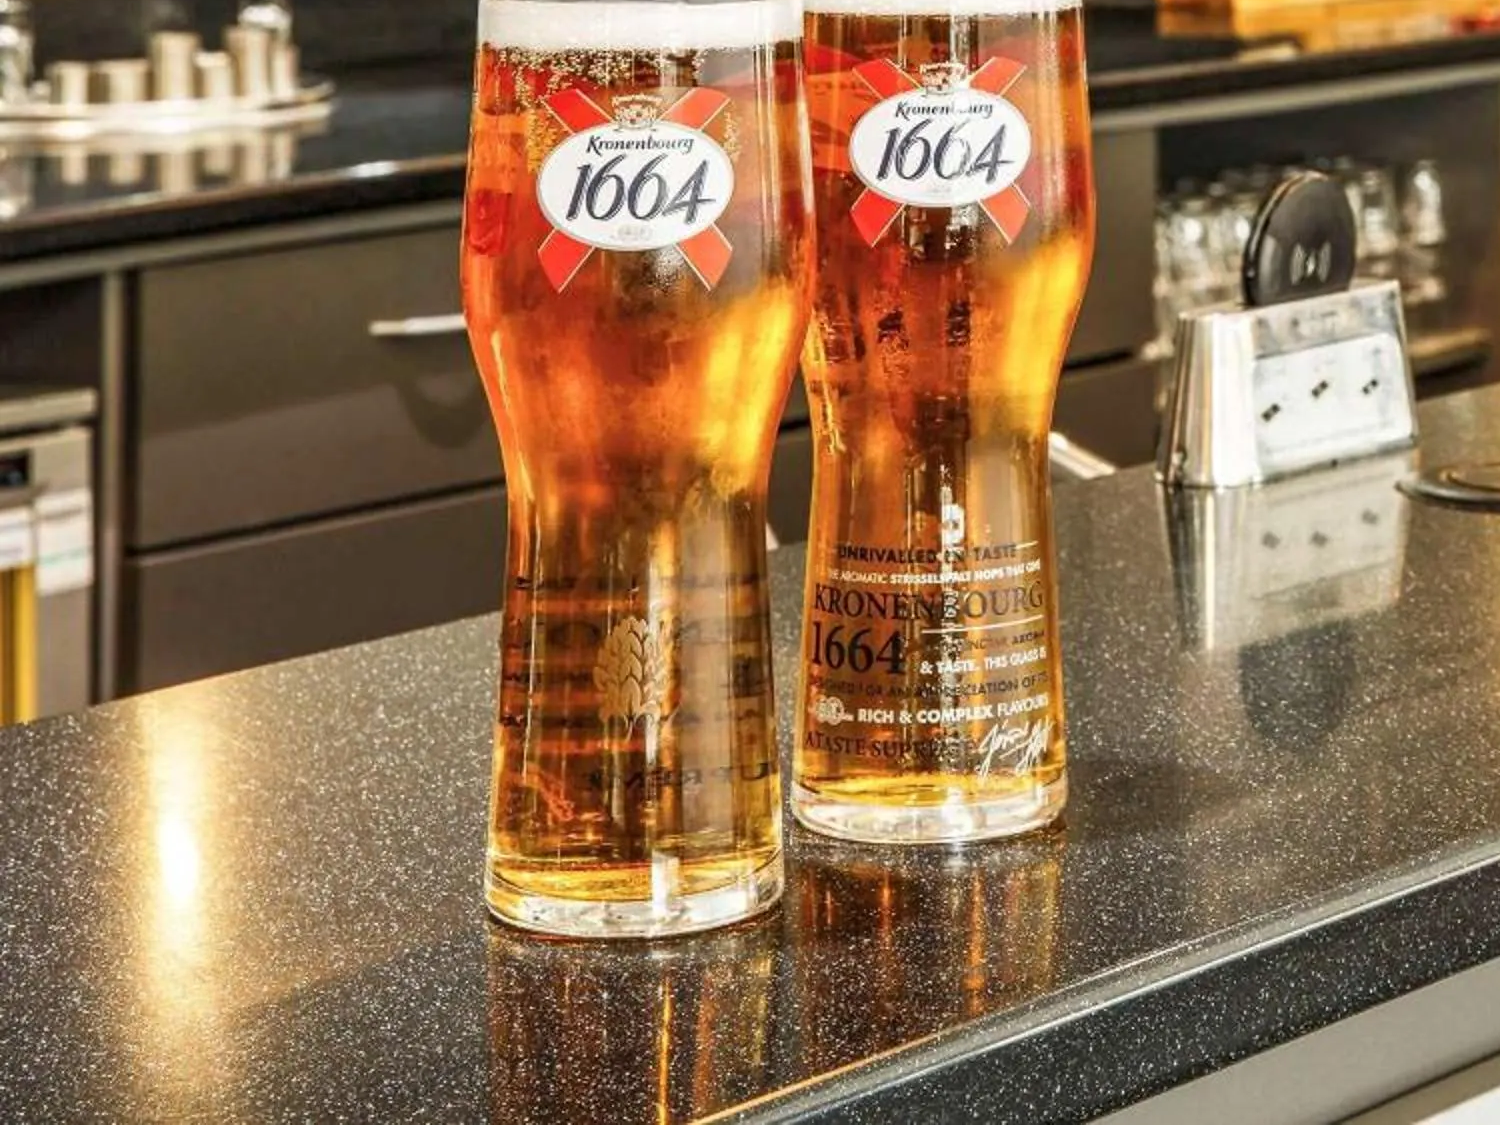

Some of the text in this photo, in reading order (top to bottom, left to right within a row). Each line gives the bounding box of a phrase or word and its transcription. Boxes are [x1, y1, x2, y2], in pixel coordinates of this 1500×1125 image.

[586, 134, 694, 156] Kronenbourg
[876, 118, 1015, 184] 1664
[566, 153, 717, 224] 1664
[974, 544, 1017, 561] TASTE
[813, 581, 1043, 622] KRONENOURG
[812, 621, 906, 674] 1664
[857, 708, 894, 724] RICH
[899, 710, 912, 725] &
[916, 704, 994, 725] COMPLEX
